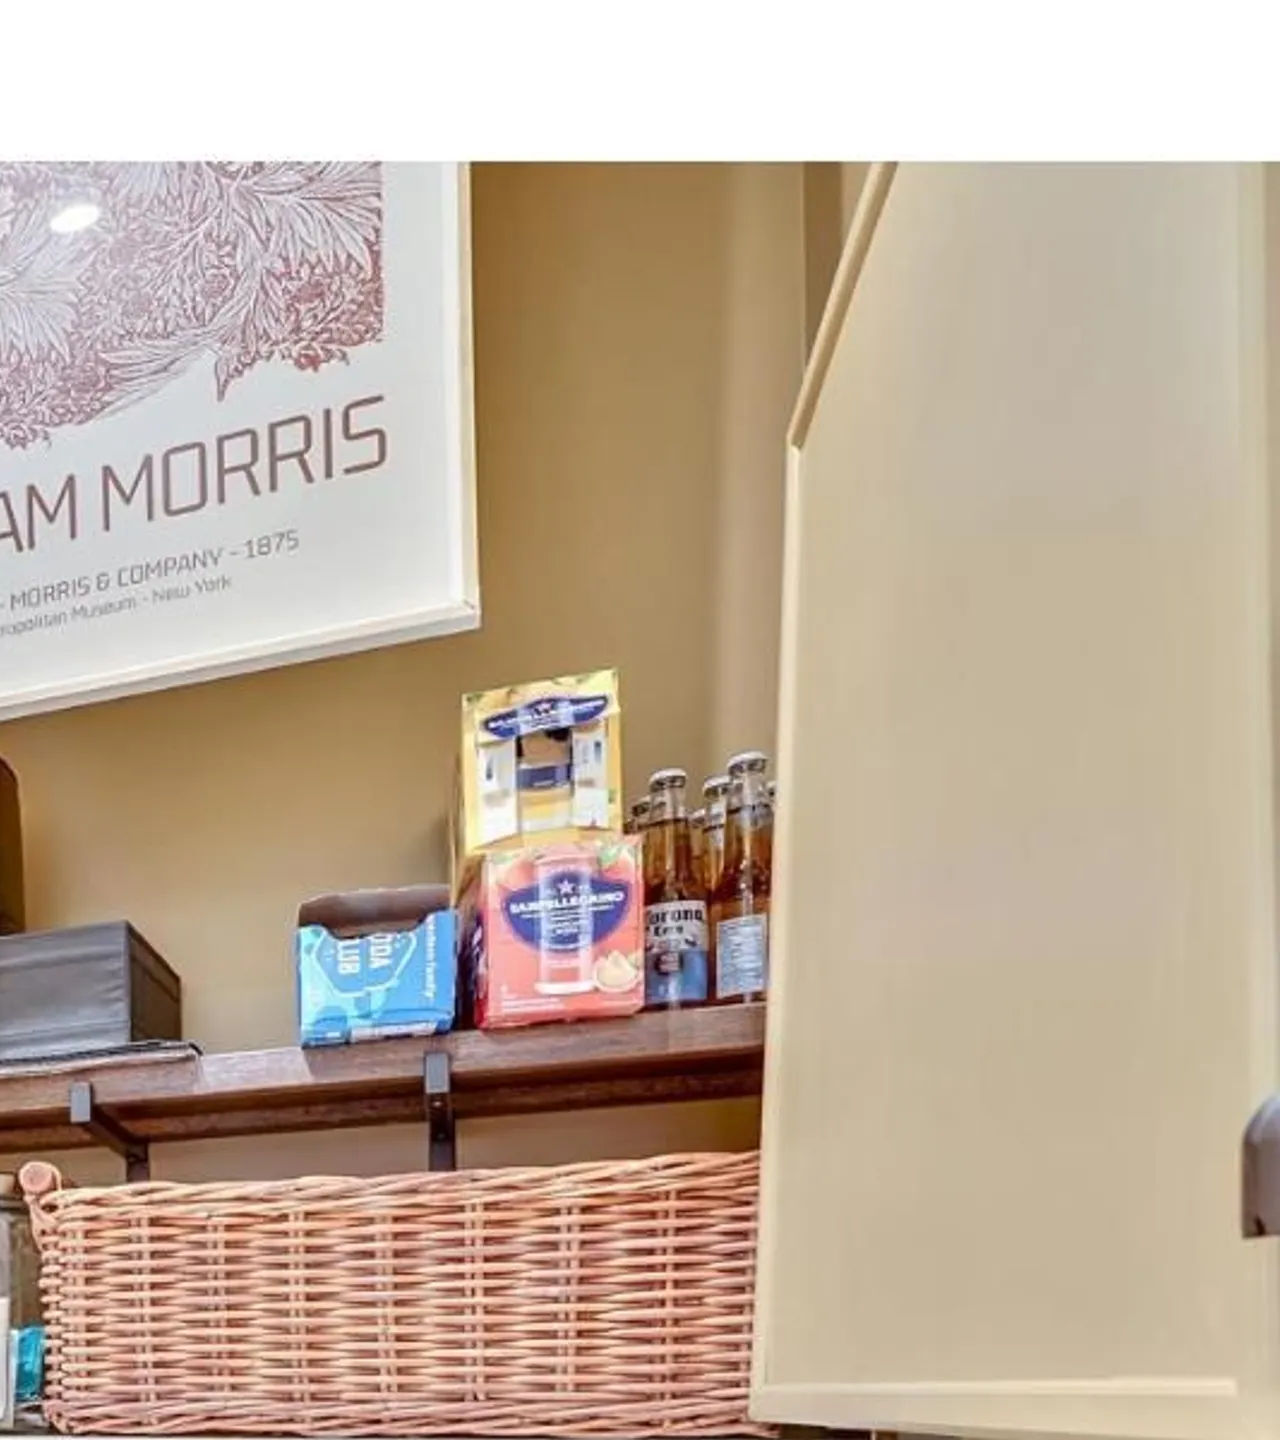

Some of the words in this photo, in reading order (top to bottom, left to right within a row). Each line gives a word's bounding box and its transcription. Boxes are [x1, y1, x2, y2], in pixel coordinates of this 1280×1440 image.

[101, 395, 387, 532] MORRIS
[10, 576, 90, 612] MORRIS
[96, 572, 110, 591] &
[117, 548, 225, 588] COMPANY
[244, 529, 300, 559] 1875
[71, 597, 137, 620] Museum
[152, 584, 190, 604] New
[194, 575, 232, 595] York
[338, 938, 360, 975] LUB
[368, 933, 392, 969] ODA
